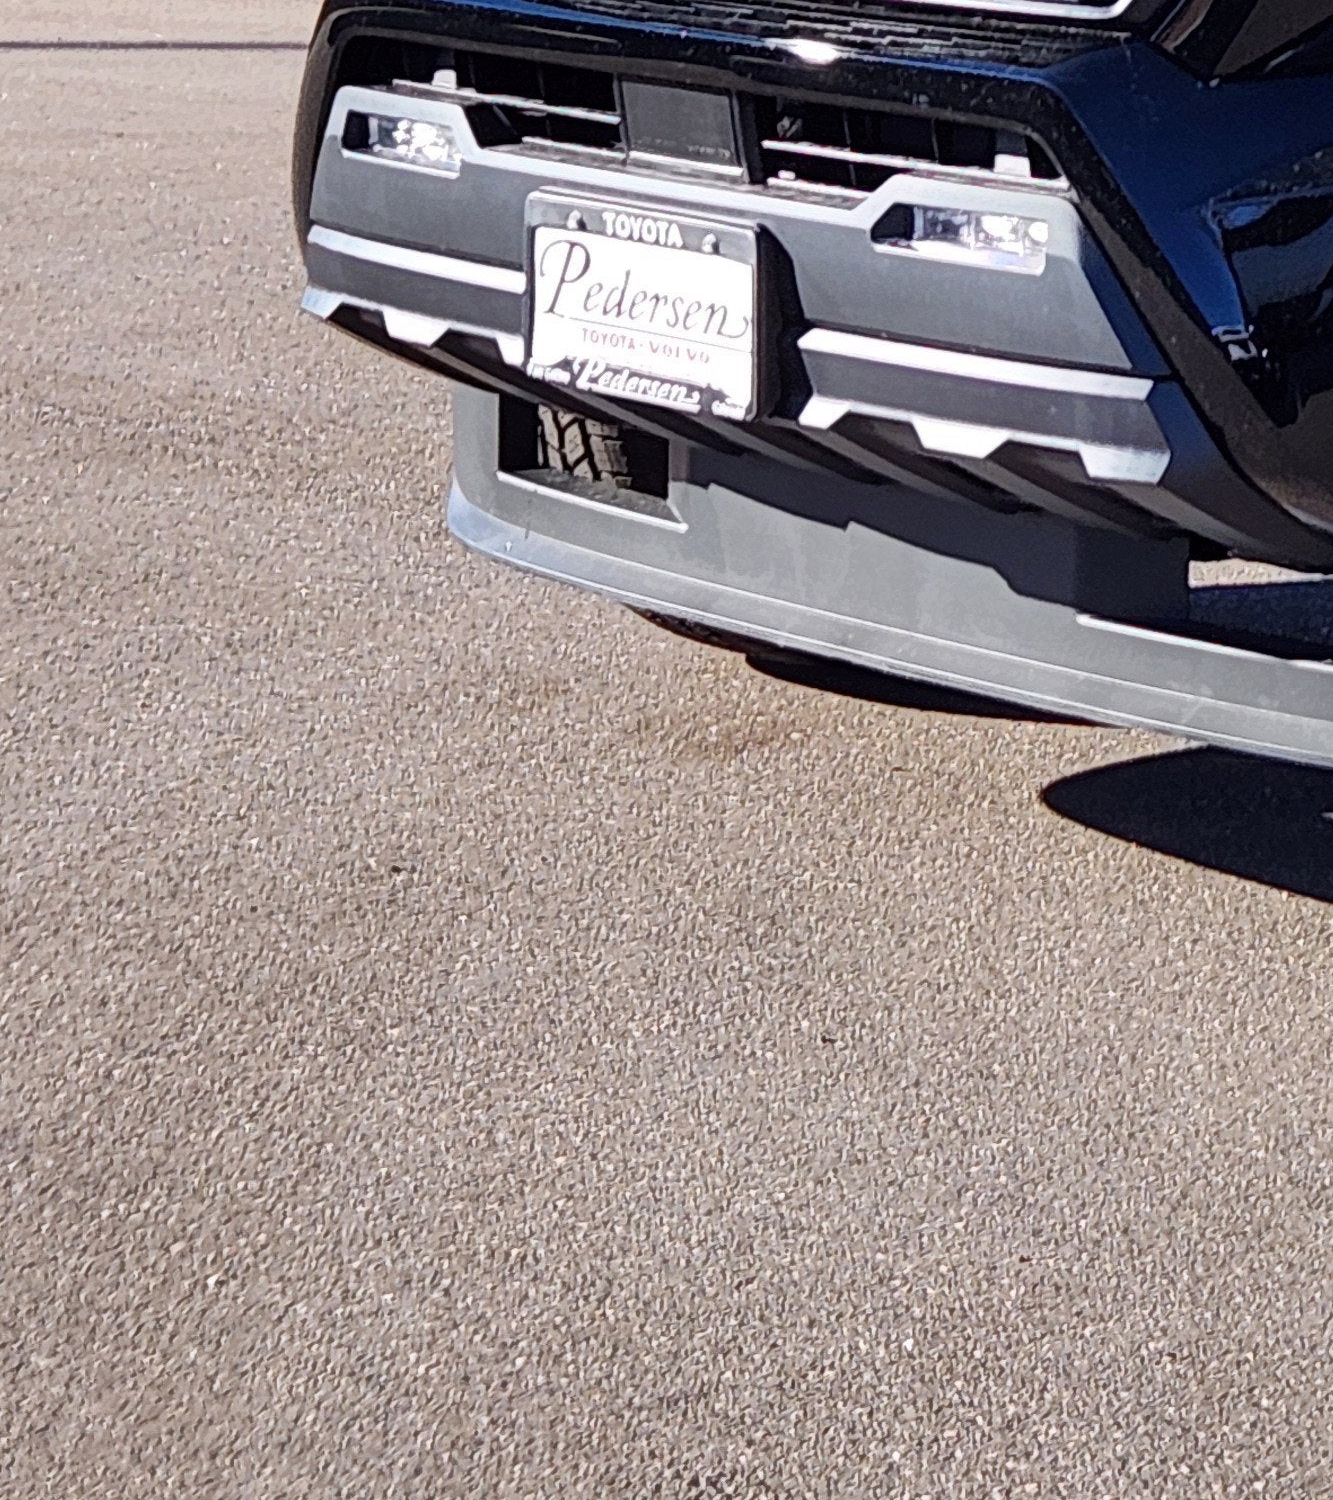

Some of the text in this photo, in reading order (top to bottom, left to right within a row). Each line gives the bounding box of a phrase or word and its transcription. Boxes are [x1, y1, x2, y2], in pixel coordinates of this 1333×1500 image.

[602, 211, 685, 249] TOYOTA
[539, 239, 750, 339] Pedersen
[581, 327, 636, 351] TOYOTA
[571, 355, 702, 406] Pedersen
